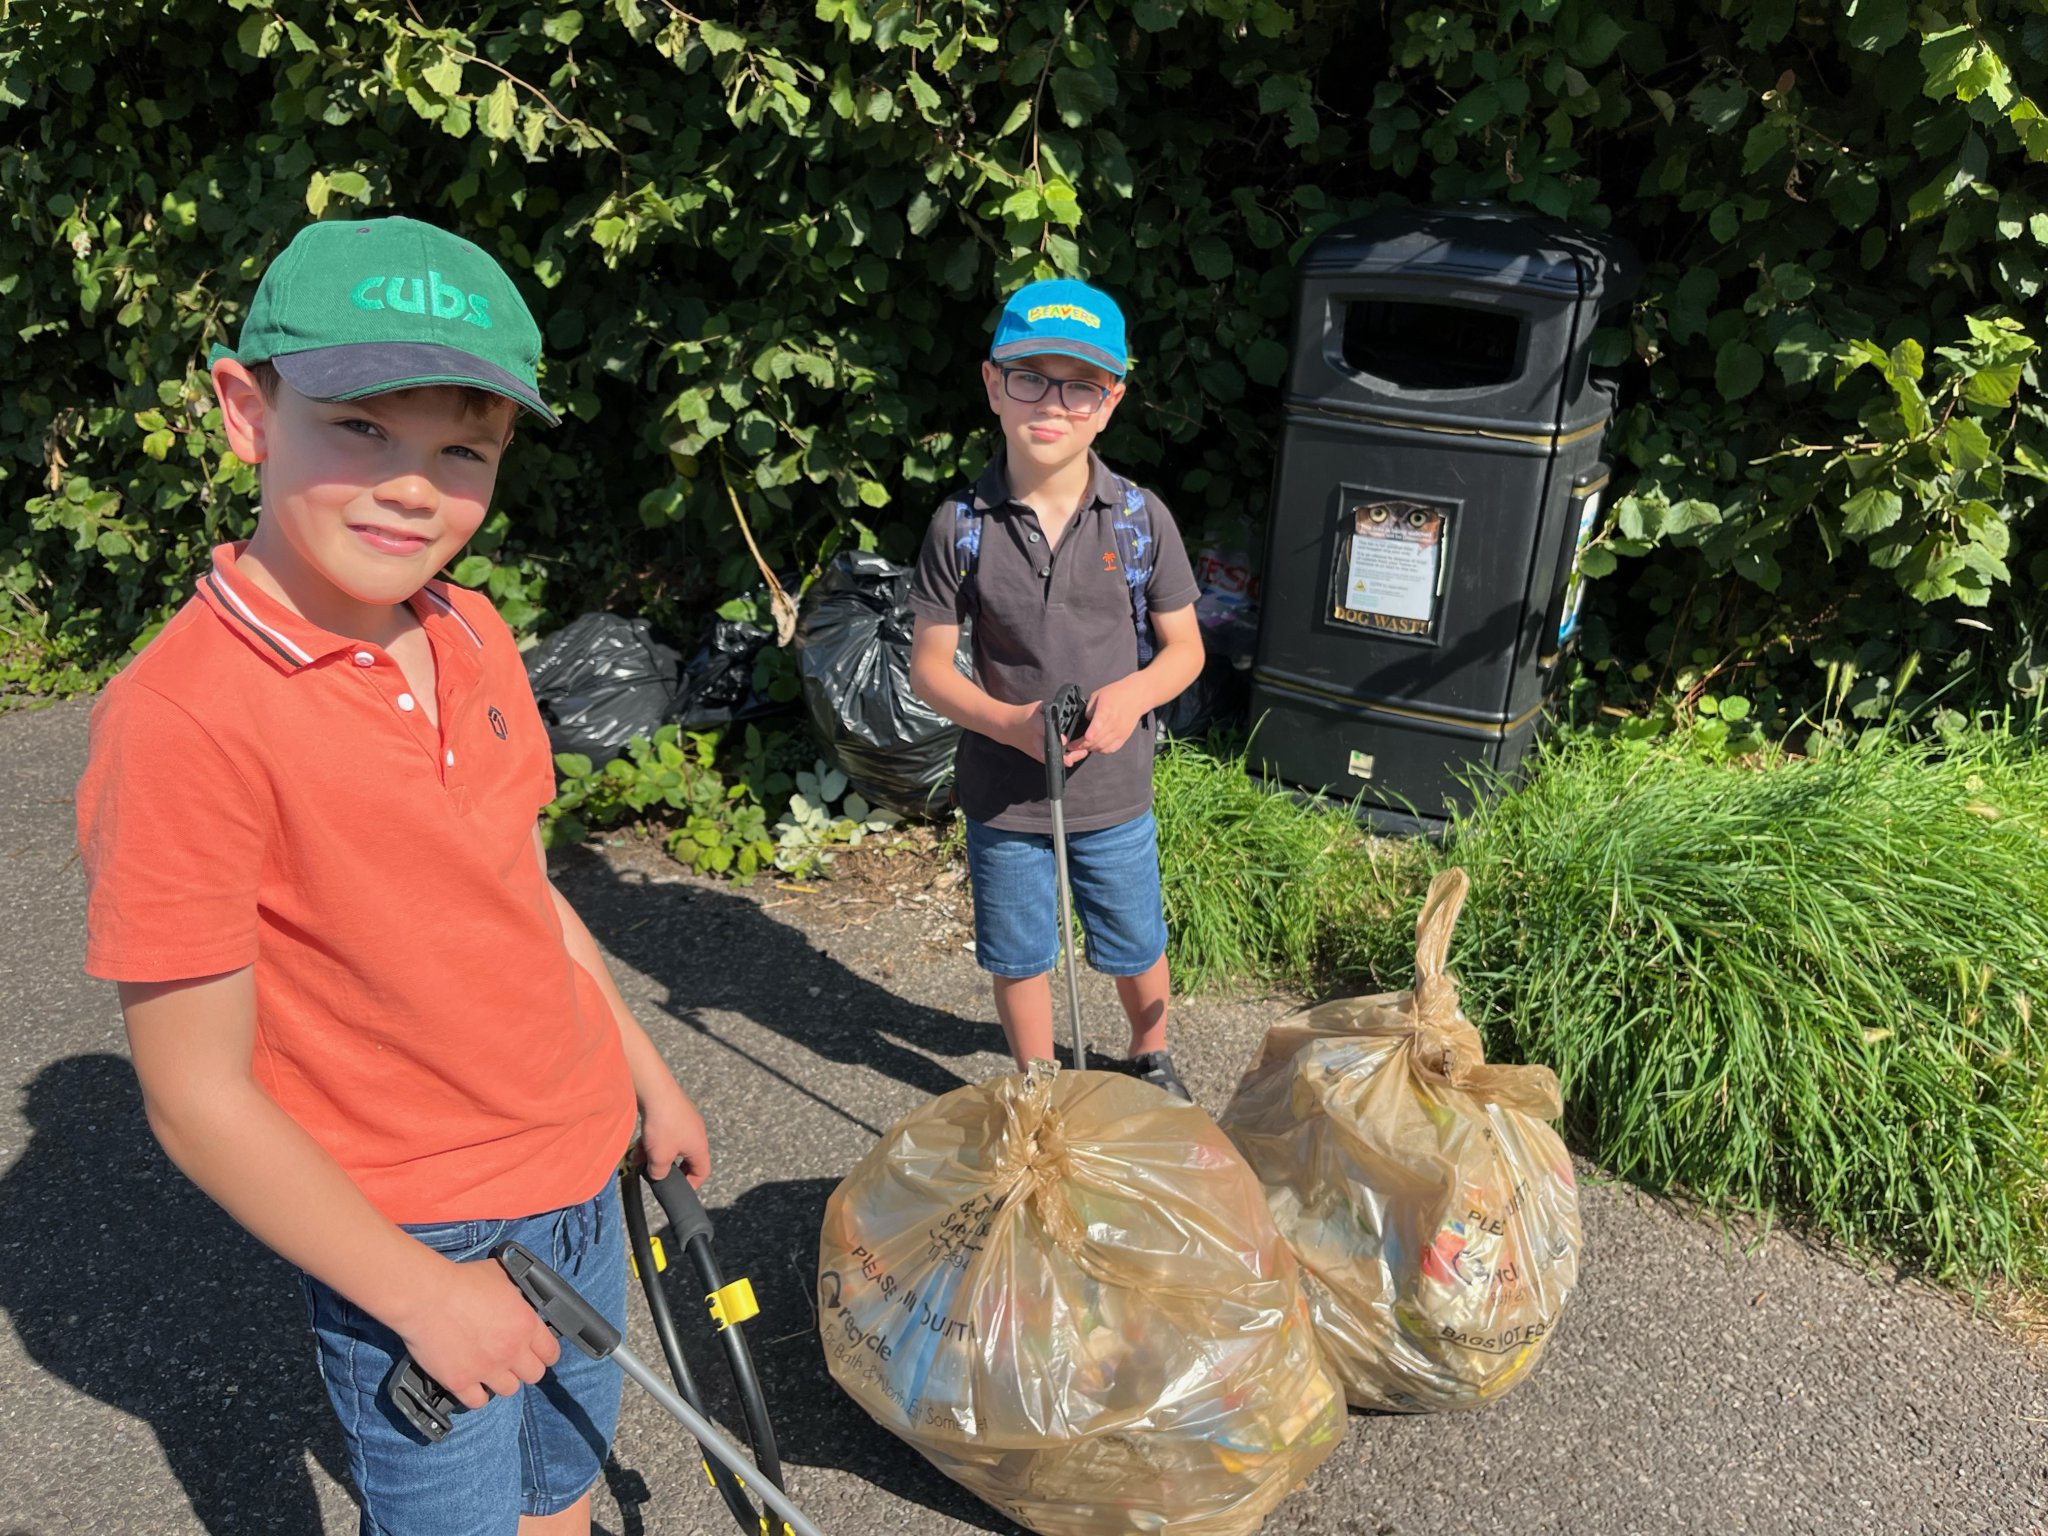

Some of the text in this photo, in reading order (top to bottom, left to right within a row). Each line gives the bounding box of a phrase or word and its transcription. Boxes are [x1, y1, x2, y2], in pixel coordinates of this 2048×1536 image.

[351, 270, 493, 330] cubs
[1027, 304, 1100, 328] BEAVERS
[1335, 606, 1369, 626] DOG
[852, 1246, 897, 1302] PLEASE
[838, 1307, 893, 1361] recycle
[1441, 1326, 1497, 1349] BAGS
[834, 1342, 863, 1369] Bath
